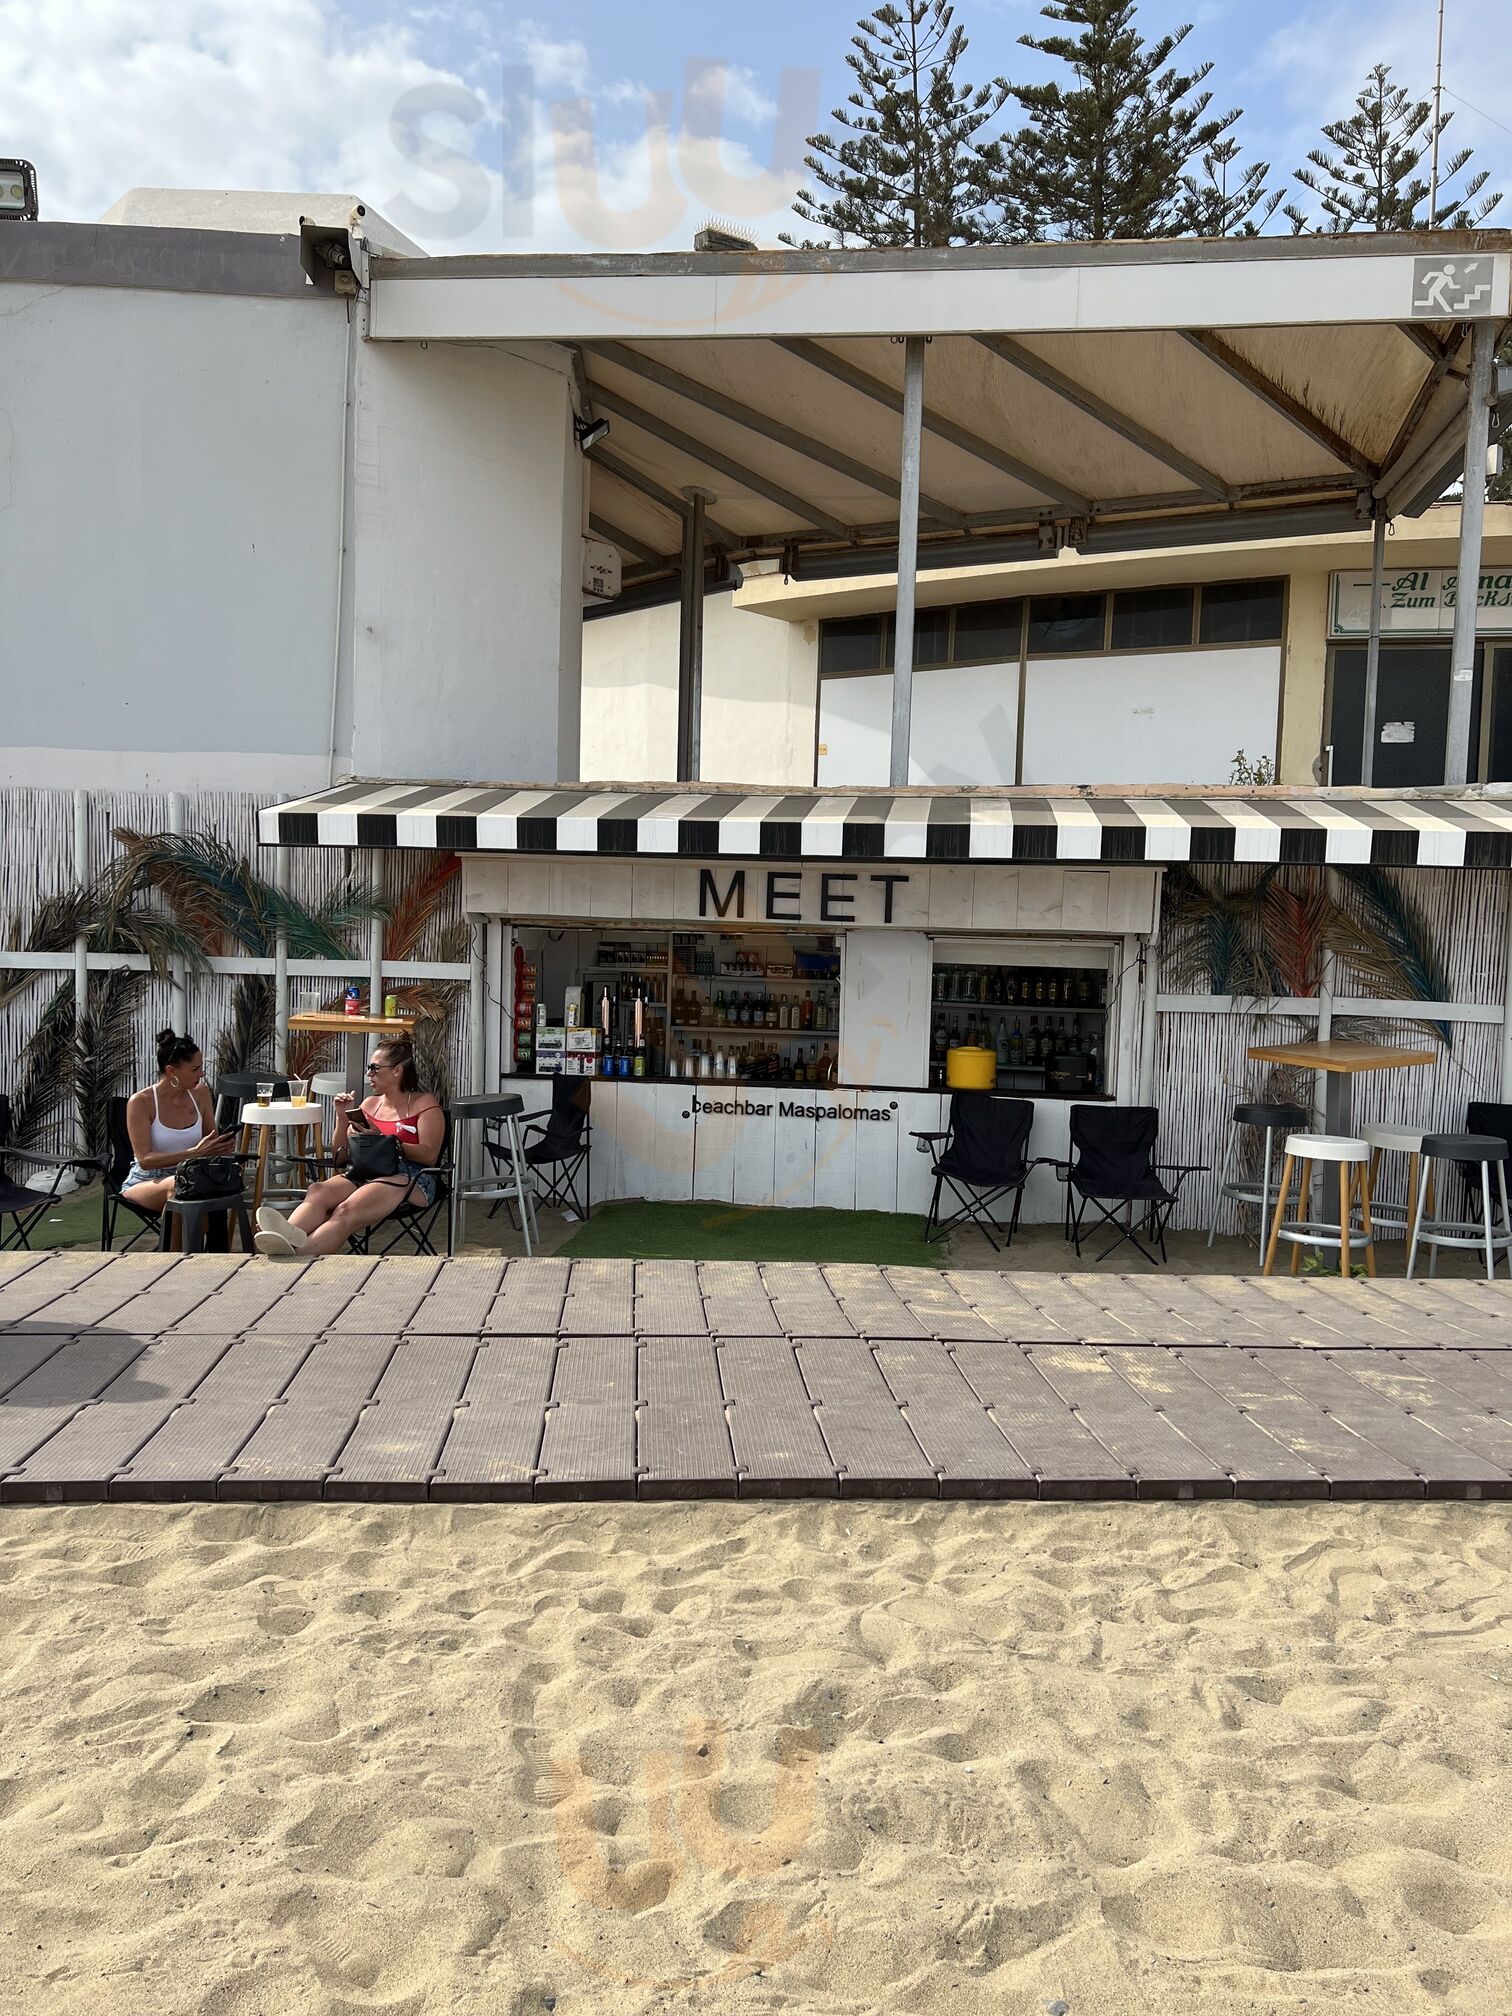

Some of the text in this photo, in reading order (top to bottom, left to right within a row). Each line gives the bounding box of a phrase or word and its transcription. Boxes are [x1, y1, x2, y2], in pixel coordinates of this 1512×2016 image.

[1391, 572, 1429, 591] Al
[698, 869, 909, 923] MEET
[692, 1095, 773, 1117] beachbar
[778, 1101, 891, 1122] Maspalomas
